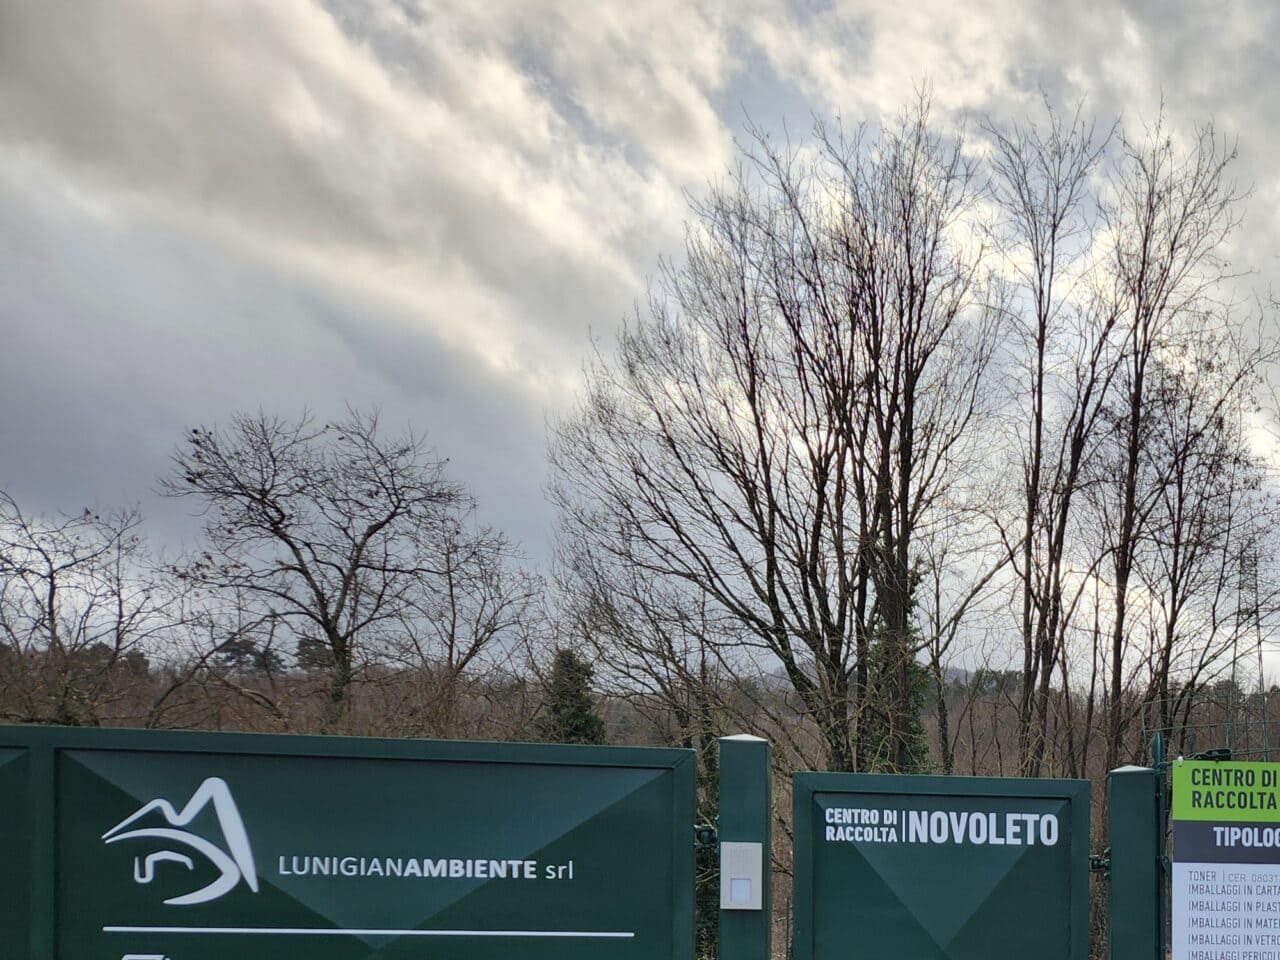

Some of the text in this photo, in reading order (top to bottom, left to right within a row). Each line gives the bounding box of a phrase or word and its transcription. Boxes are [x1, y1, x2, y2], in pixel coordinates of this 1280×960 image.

[1192, 768, 1277, 787] CENTRO DI
[1192, 790, 1277, 810] RACCOLTA
[825, 808, 897, 825] CENTRO DI
[825, 826, 897, 842] RACCOLTA
[908, 810, 1059, 846] NOVOLETO
[279, 855, 574, 880] LUNIGIANAMBIENTE srl
[1189, 871, 1217, 882] TONER
[1188, 885, 1241, 896] IMBALLAGGI
[1244, 885, 1253, 896] IN
[1188, 902, 1241, 912] IMBALLAGGI
[1244, 902, 1253, 912] IN
[1188, 918, 1241, 929] IMBALLAGGI
[1244, 918, 1253, 929] IN
[1188, 935, 1241, 945] IMBALLAGGI
[1244, 935, 1253, 945] IN
[1188, 951, 1240, 960] IMBALLAGGI
